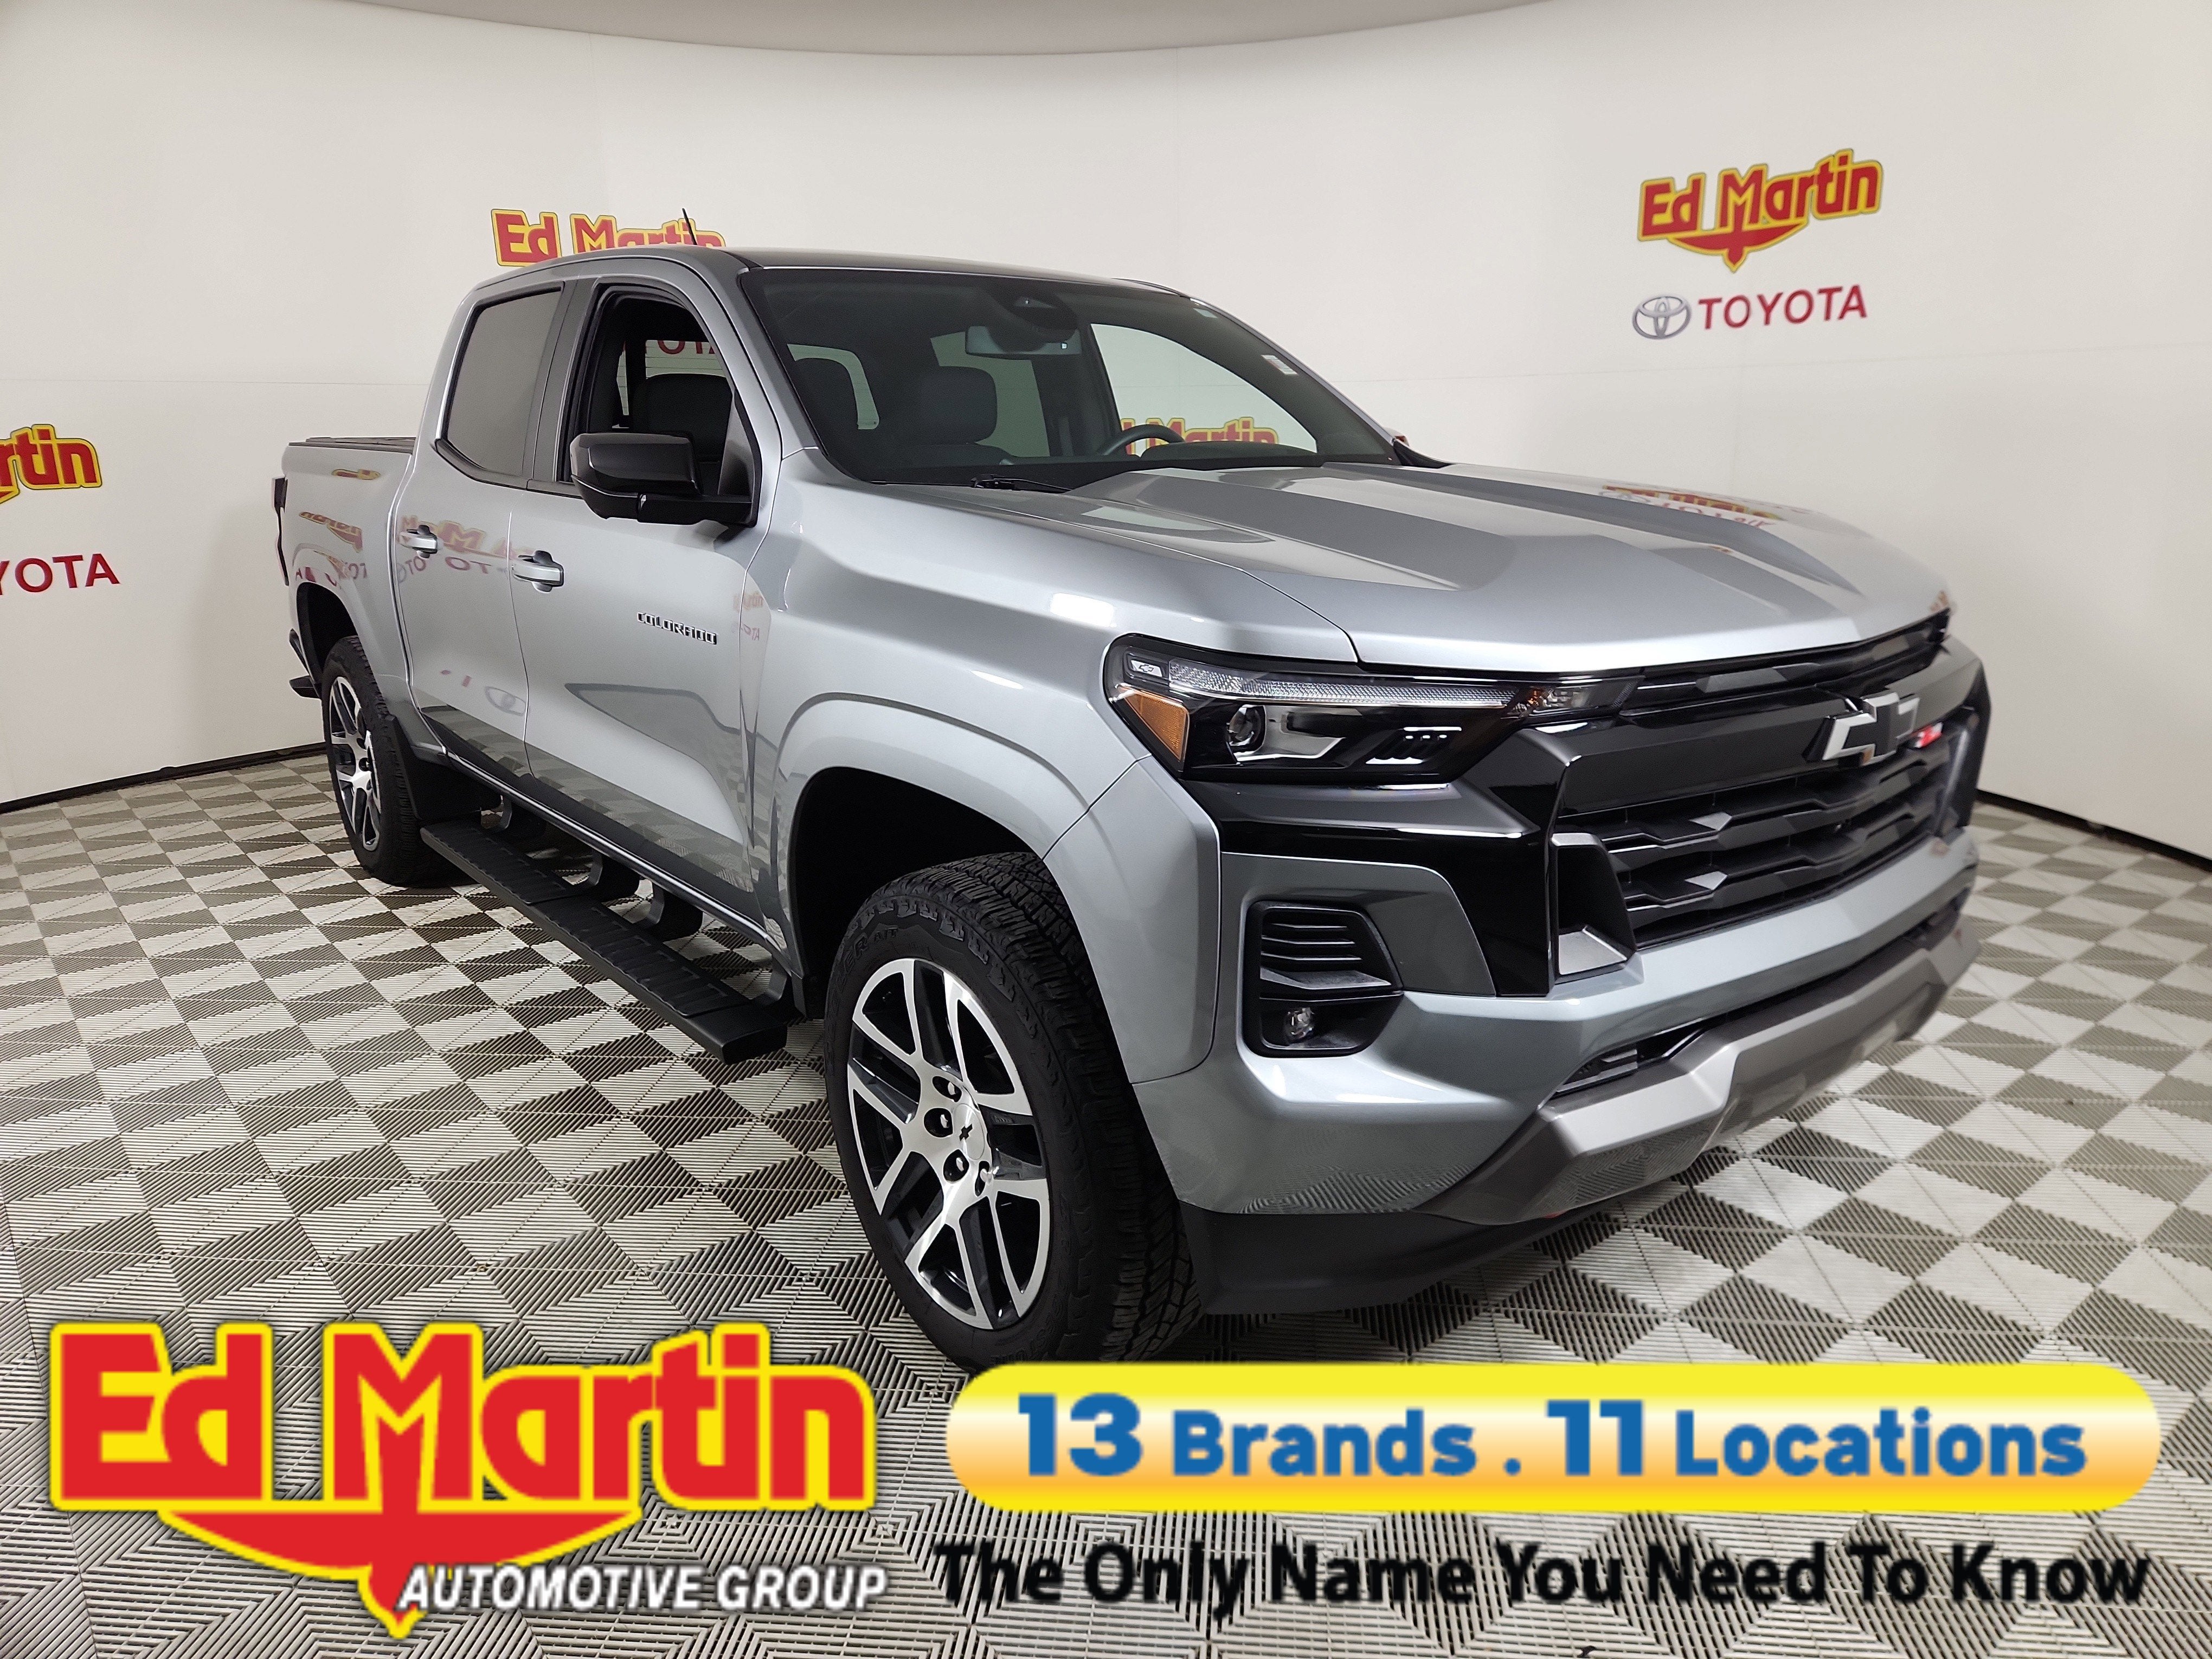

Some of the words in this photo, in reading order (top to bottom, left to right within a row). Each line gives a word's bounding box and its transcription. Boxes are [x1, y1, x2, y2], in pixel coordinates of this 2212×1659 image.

[1642, 178, 1701, 236] Ed
[1720, 153, 1879, 227] Martin
[495, 212, 559, 263] Ed
[1698, 285, 1868, 330] TOYOTA
[637, 612, 717, 645] COLORADO
